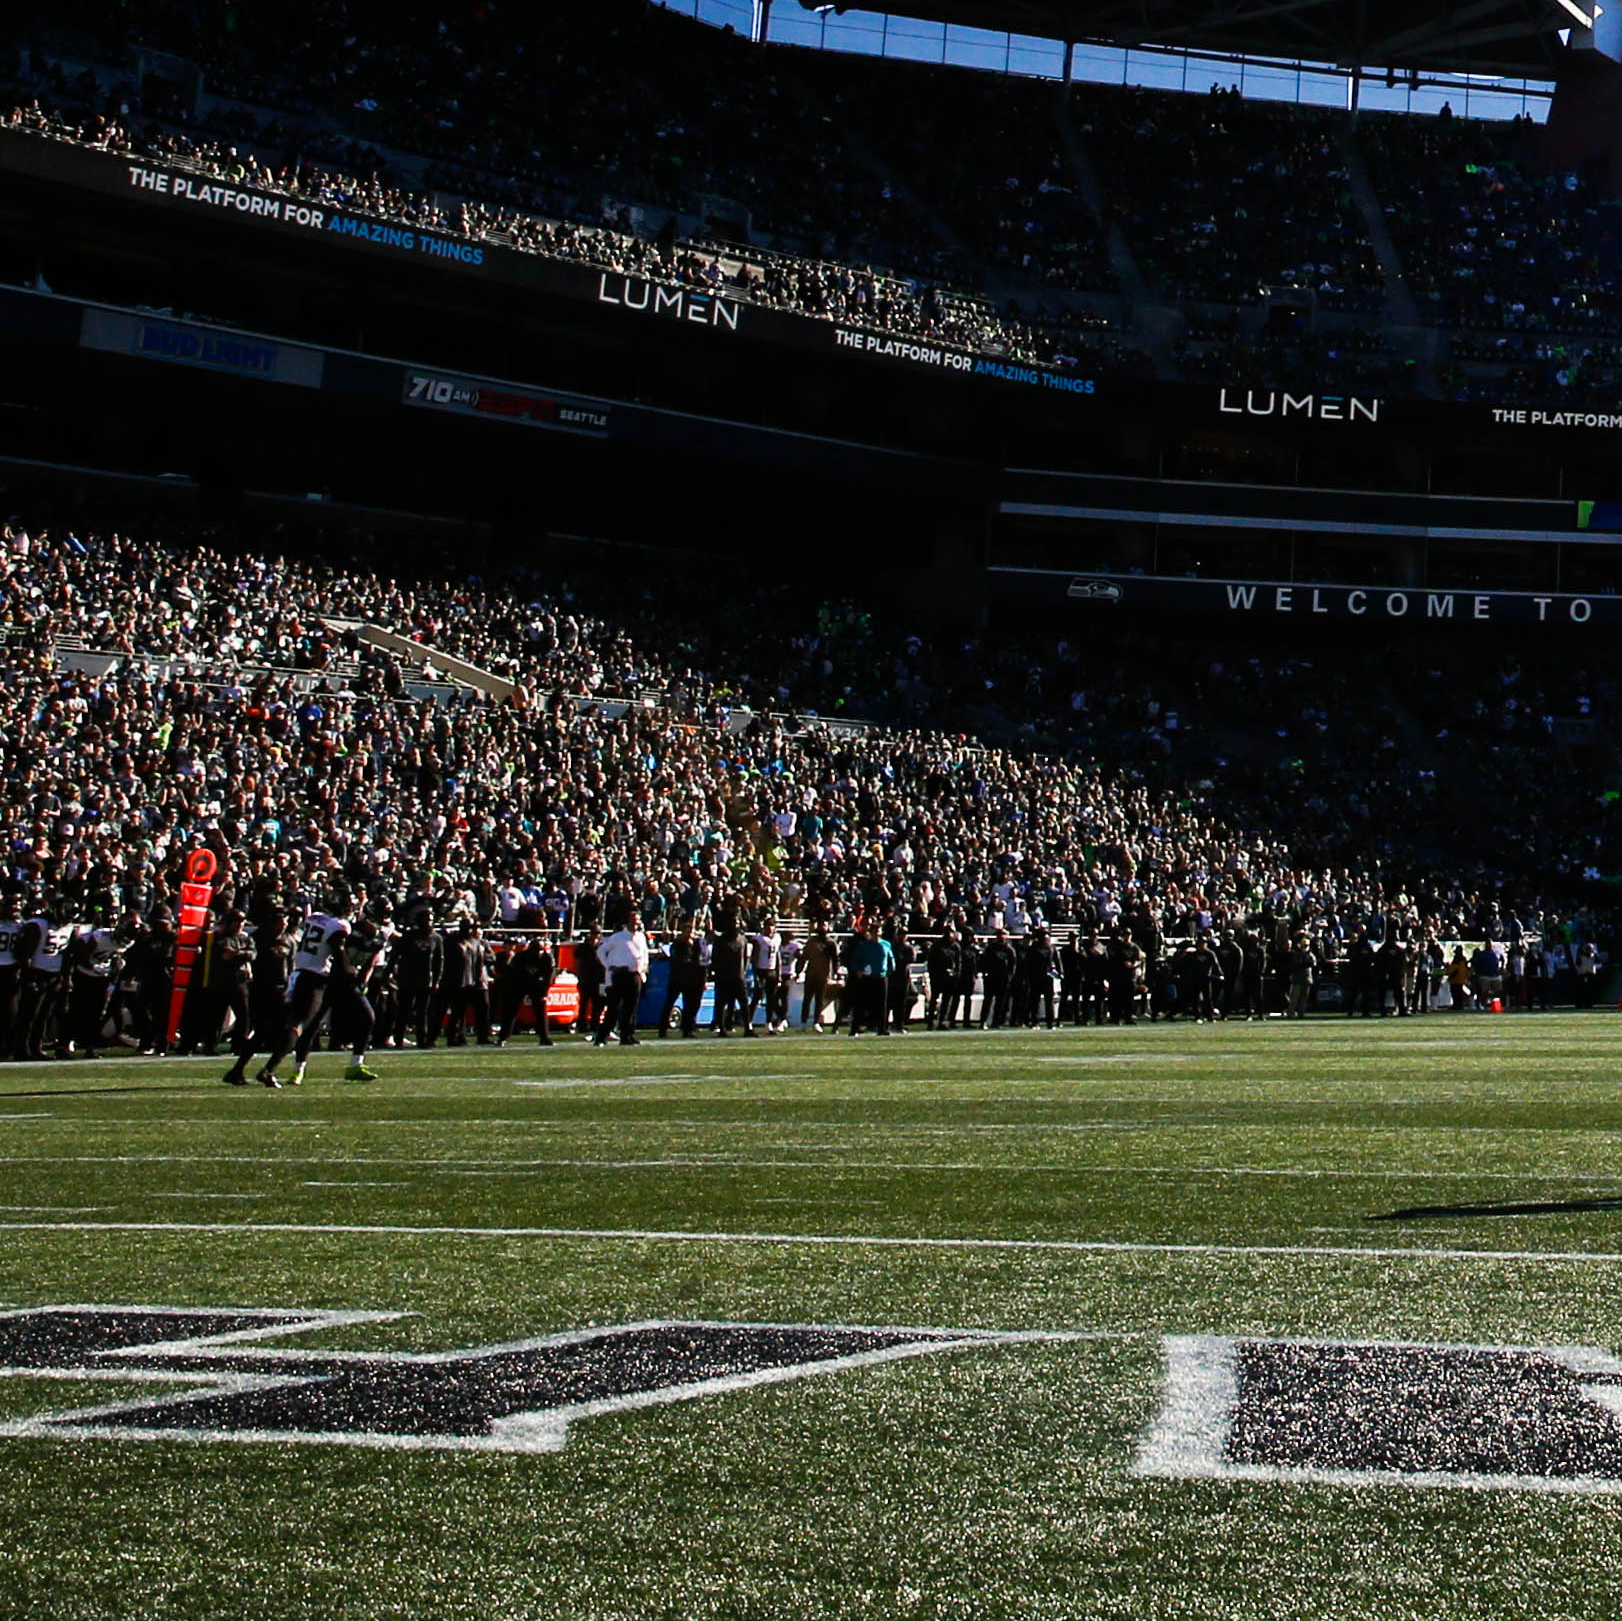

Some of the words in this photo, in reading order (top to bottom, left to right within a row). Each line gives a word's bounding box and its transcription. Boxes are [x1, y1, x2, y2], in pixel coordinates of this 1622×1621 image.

[129, 166, 169, 193] THE
[173, 176, 280, 220] PLATFORM
[284, 203, 325, 229] FOR
[327, 215, 414, 250] AMAZING
[419, 236, 484, 265] THINGS
[599, 274, 739, 330] LUMEN
[834, 329, 864, 350] THE
[867, 333, 941, 367] PLATFORM
[944, 350, 972, 372] FOR
[974, 358, 1038, 386] AMAZING
[1042, 371, 1095, 394] THINGS
[408, 377, 453, 402] 710
[453, 391, 471, 404] AM
[560, 409, 607, 427] SEATTLE
[1218, 387, 1379, 423] LUMEN
[1492, 409, 1527, 426] THE
[1530, 410, 1622, 431] PLATFORM
[1225, 584, 1491, 620] WELCOME
[1533, 597, 1592, 624] TO
